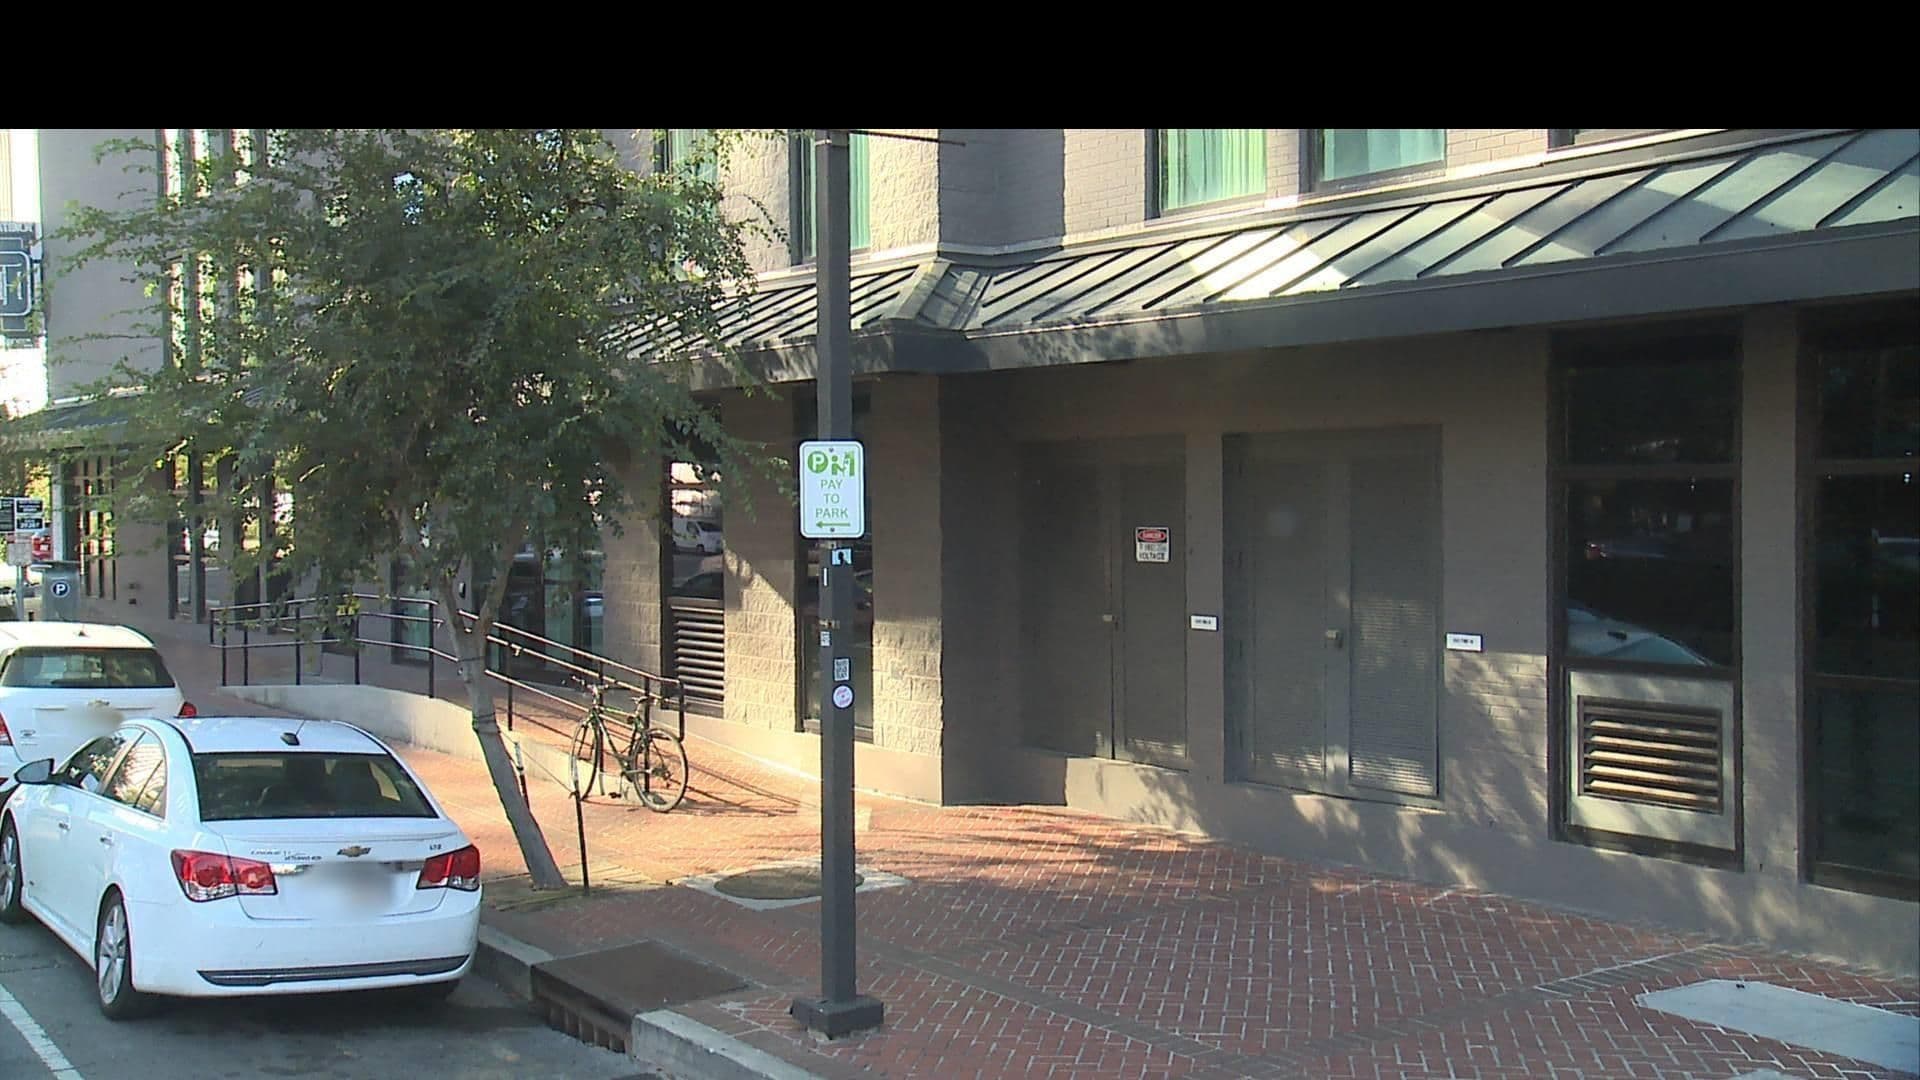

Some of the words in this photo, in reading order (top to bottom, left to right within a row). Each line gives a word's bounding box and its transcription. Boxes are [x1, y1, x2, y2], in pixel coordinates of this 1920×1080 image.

[820, 480, 843, 489] PAY
[823, 493, 840, 504] TO
[815, 508, 849, 519] PARK
[55, 583, 66, 595] P
